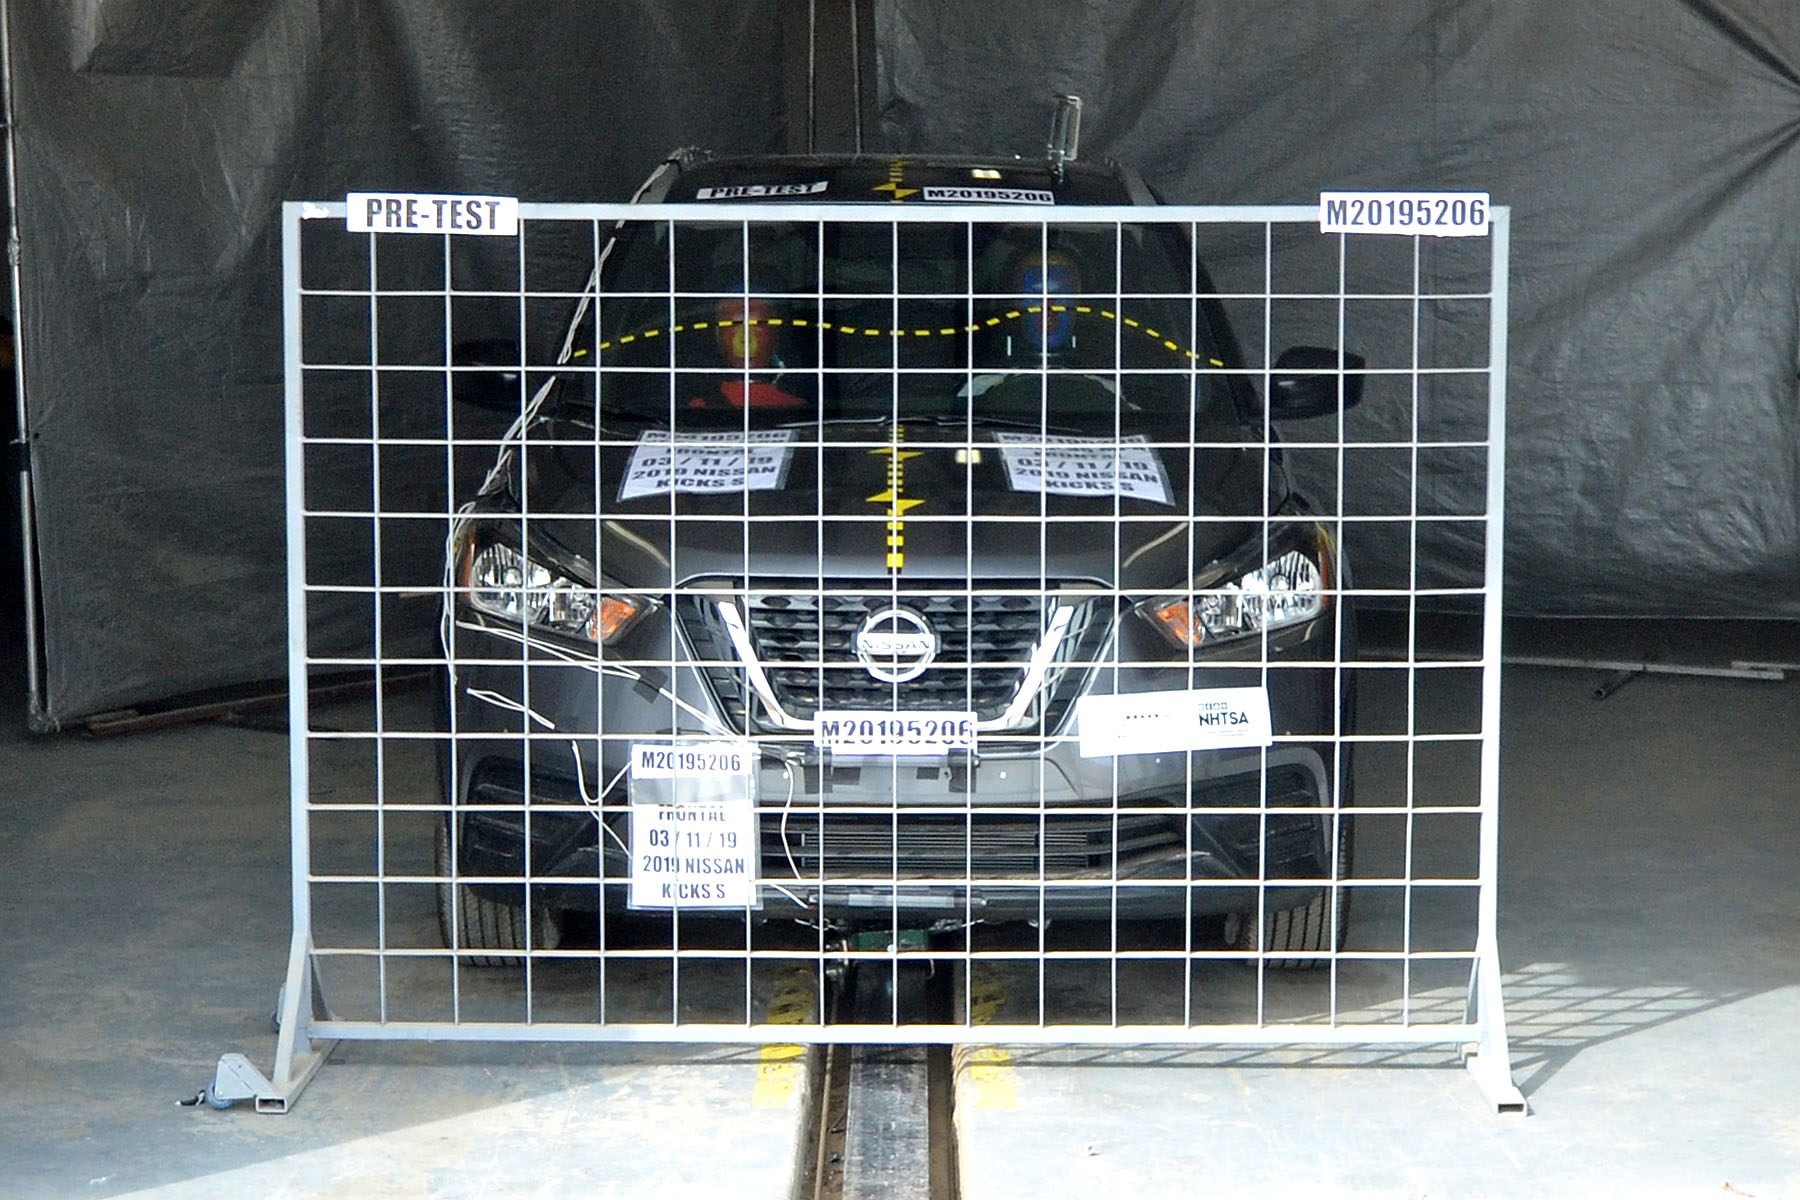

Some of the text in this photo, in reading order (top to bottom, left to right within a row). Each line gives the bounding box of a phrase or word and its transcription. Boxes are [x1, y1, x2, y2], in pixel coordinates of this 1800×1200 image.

[928, 190, 1052, 202] M20195206
[367, 198, 500, 230] PRE-TEST
[1327, 199, 1485, 226] M20195206
[694, 467, 776, 477] NISSAN
[1076, 472, 1158, 483] NISSAN
[1199, 712, 1249, 726] NHTSA
[821, 720, 973, 744] M20195206
[642, 751, 741, 771] M20195206
[649, 829, 669, 847] 03
[687, 831, 701, 847] 11
[720, 831, 737, 848] 19
[643, 855, 744, 874] 2019 NISSAN
[662, 883, 726, 899] KCKS S
